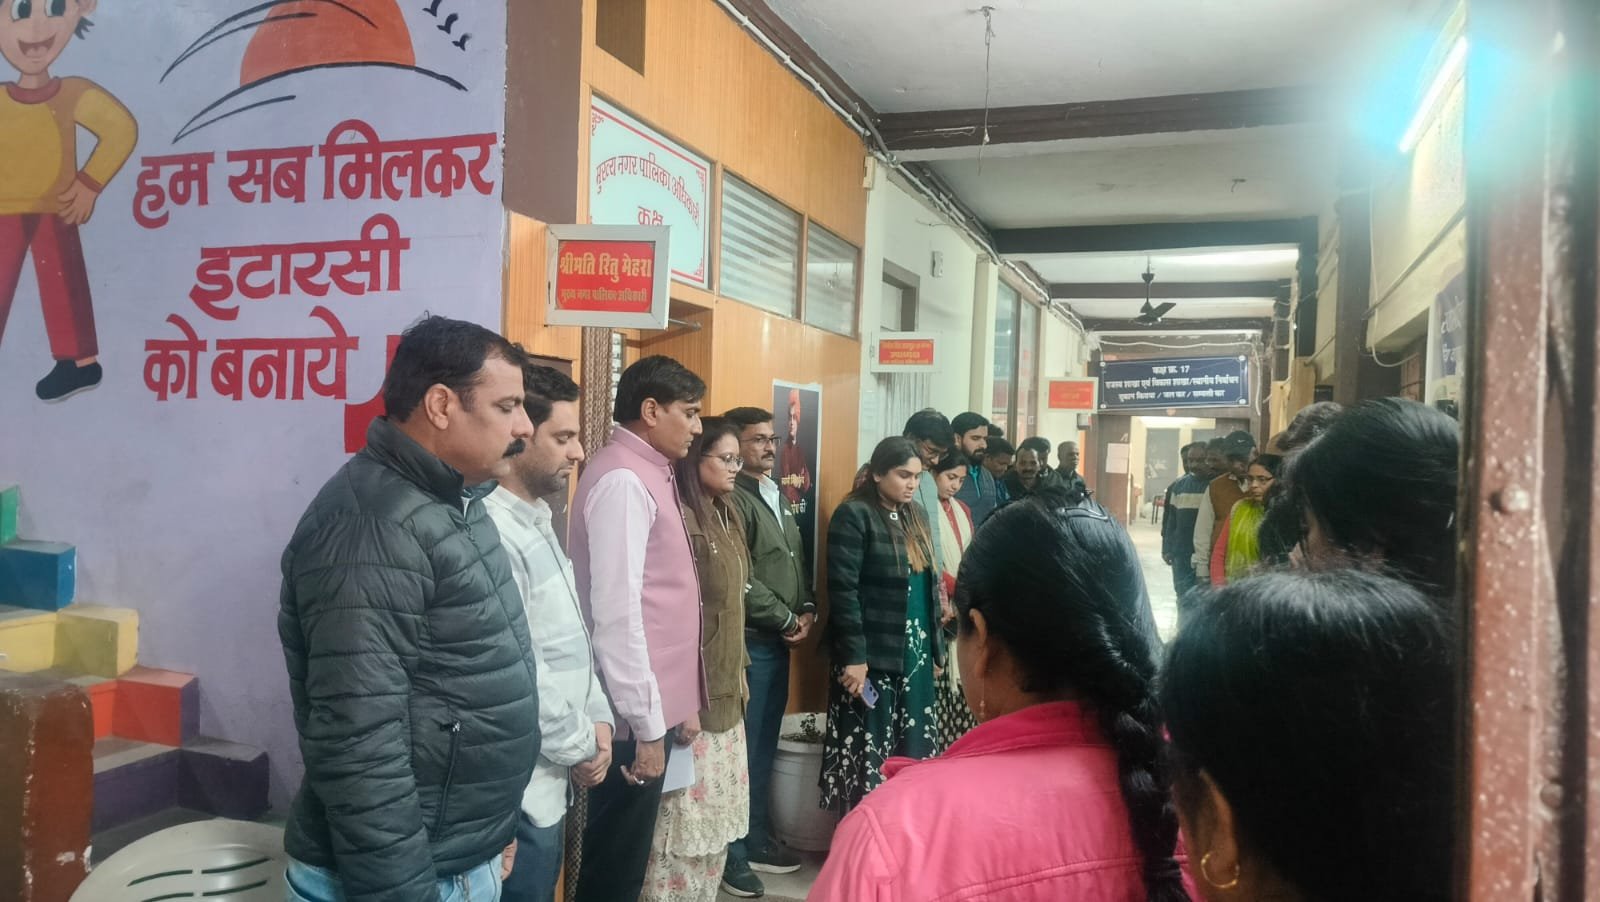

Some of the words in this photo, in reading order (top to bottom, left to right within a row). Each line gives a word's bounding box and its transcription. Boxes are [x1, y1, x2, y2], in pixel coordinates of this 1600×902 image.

[133, 152, 215, 229] हम
[227, 145, 314, 204] सब
[320, 119, 497, 200] मिलकर
[618, 155, 639, 177] नगर
[639, 152, 671, 190] पालिका
[189, 213, 410, 320] इटारसी
[560, 252, 596, 275] श्रीमति
[598, 252, 619, 283] रितु
[621, 253, 652, 278] मेहरा
[144, 313, 207, 401] को
[211, 305, 359, 401] बनाये
[1180, 365, 1190, 373] 17
